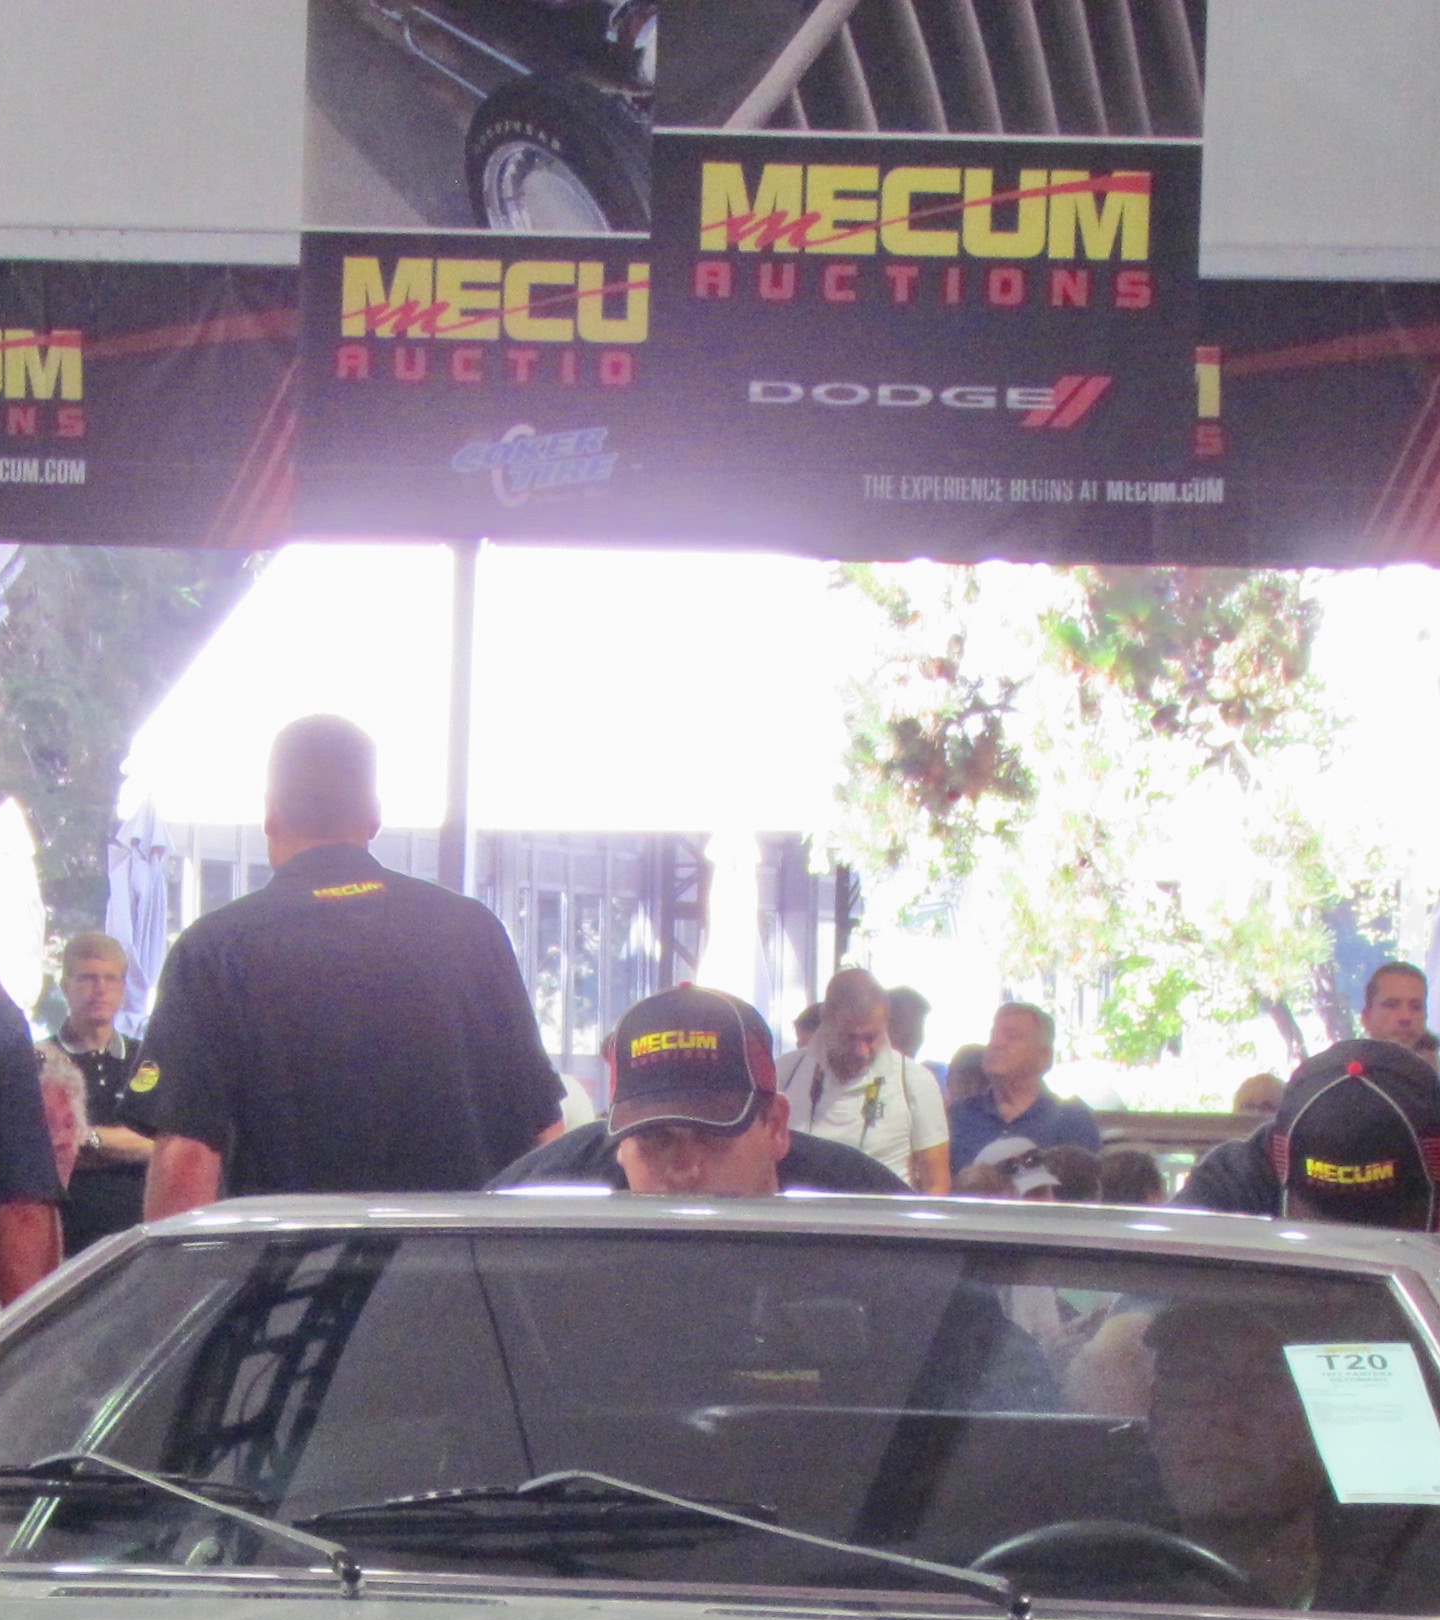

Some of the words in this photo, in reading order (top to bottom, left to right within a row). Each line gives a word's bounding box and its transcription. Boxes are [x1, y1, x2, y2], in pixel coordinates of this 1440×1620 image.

[700, 162, 1152, 261] MECUM
[341, 256, 651, 343] MECU
[694, 261, 1152, 308] AUCTIONS
[337, 345, 634, 386] AUCTIO
[749, 379, 1057, 410] DODGE
[863, 474, 892, 500] THE
[901, 475, 1002, 501] EXPERIENCE
[1010, 476, 1074, 502] BEGINS
[1106, 477, 1225, 503] MECUM.COM
[629, 1029, 718, 1059] MECUM
[1305, 1157, 1396, 1185] MECUM
[1317, 1353, 1389, 1371] T20
